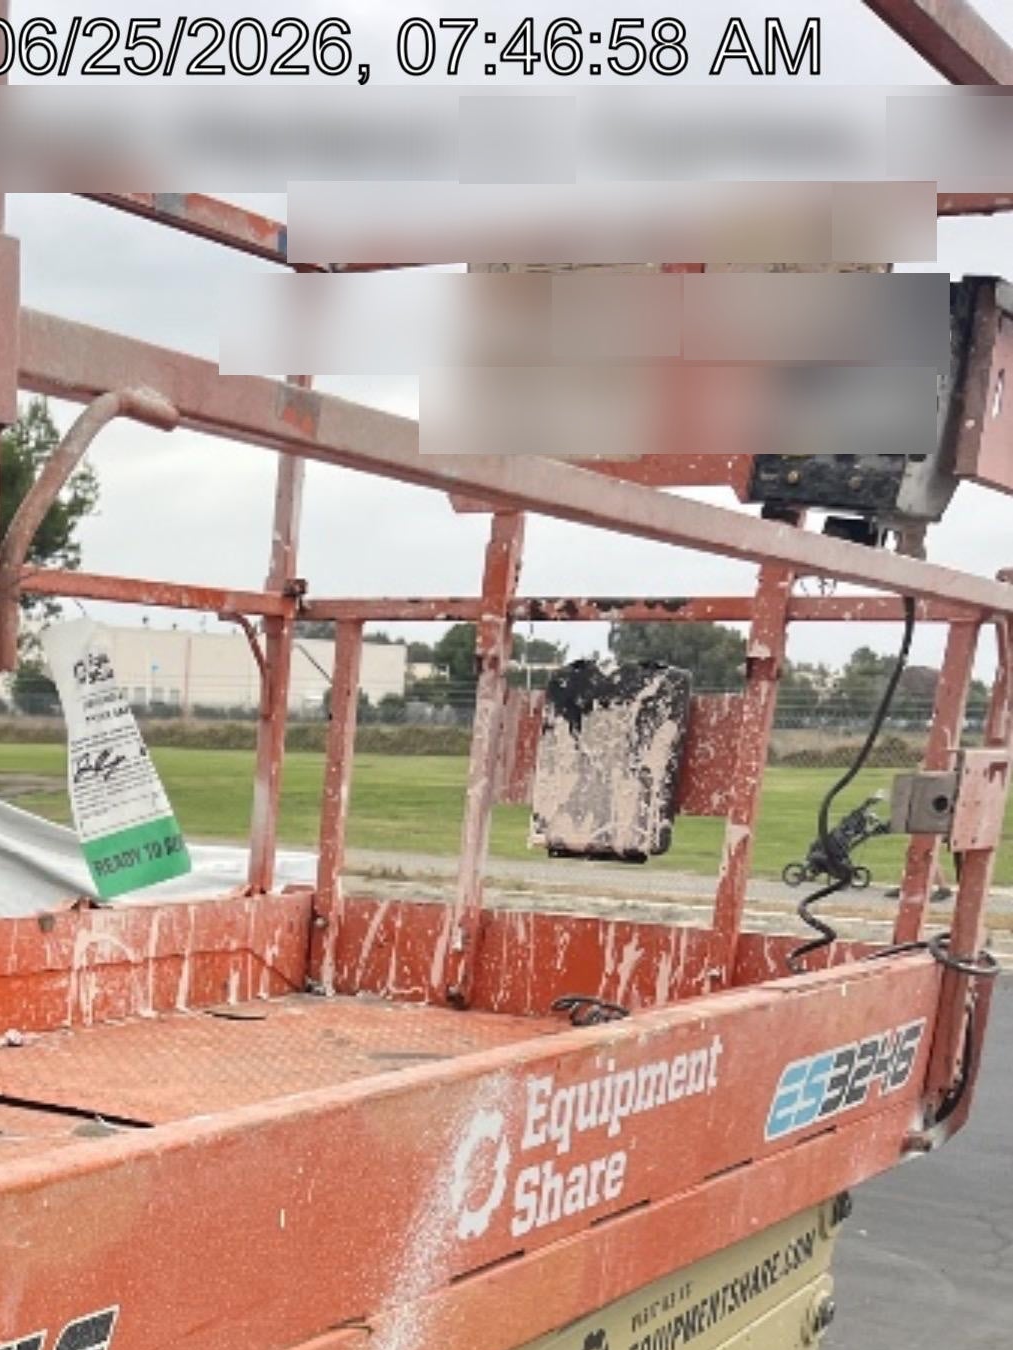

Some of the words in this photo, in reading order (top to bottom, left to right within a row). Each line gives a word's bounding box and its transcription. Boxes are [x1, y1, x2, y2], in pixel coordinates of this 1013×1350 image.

[92, 847, 142, 877] READY
[521, 1033, 723, 1154] Equipment
[511, 1150, 627, 1238] Share
